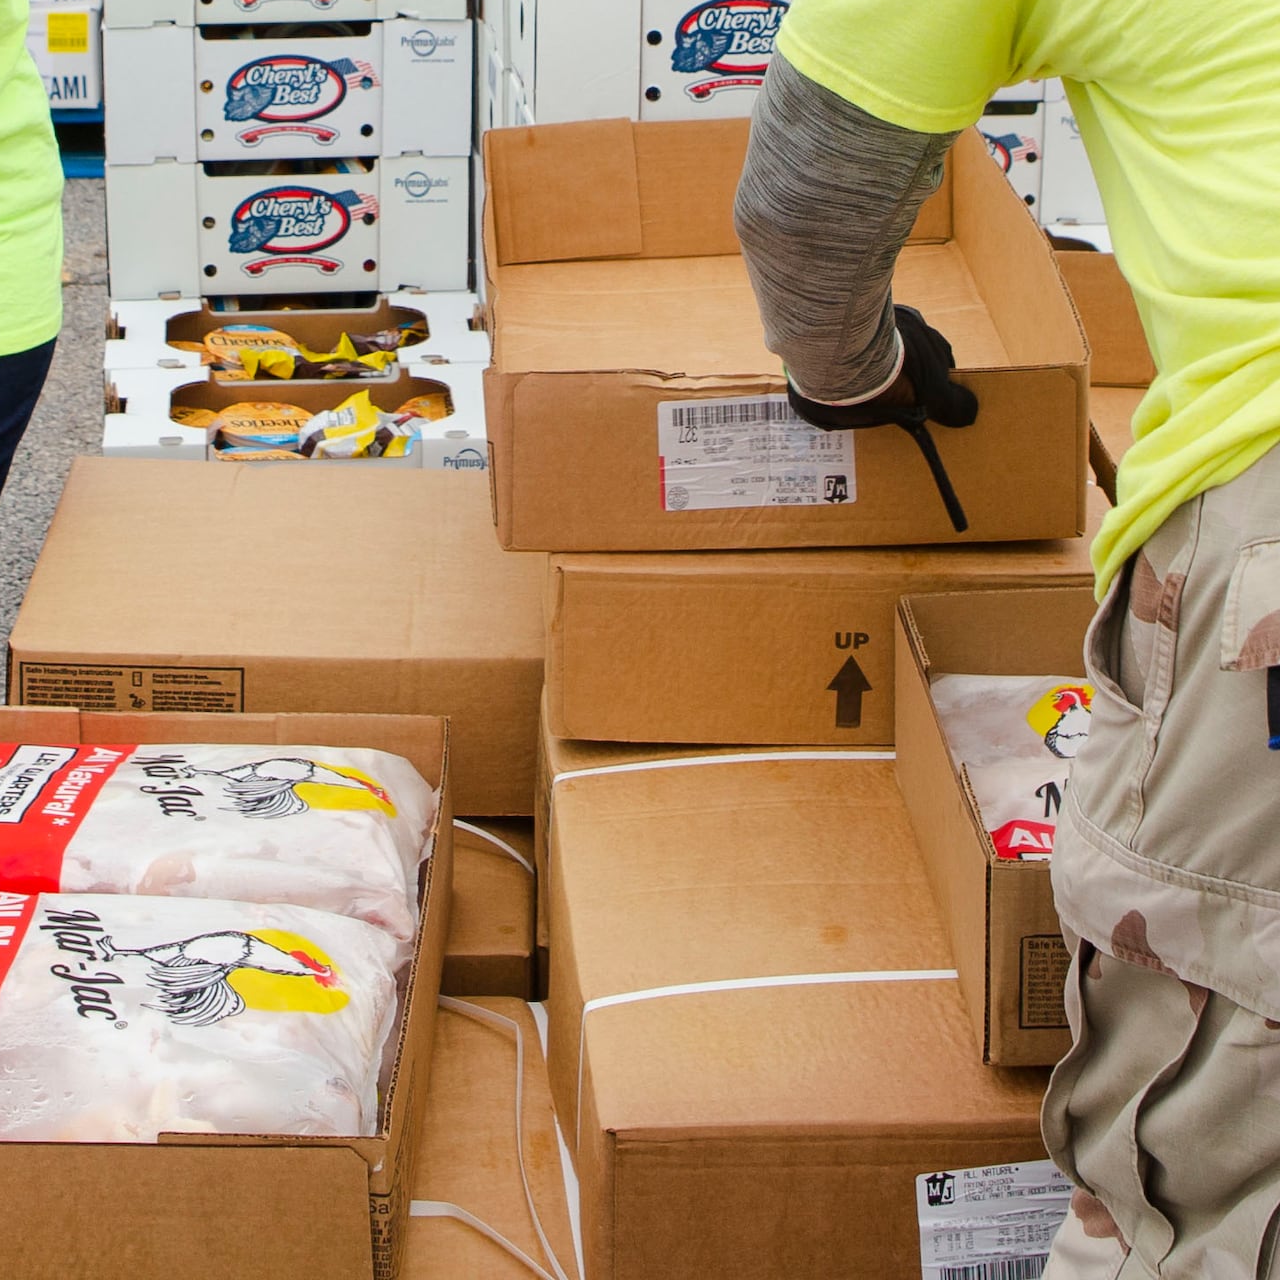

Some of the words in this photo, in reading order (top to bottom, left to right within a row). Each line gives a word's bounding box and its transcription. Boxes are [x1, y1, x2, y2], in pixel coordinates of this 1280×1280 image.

[698, 6, 786, 37] Cheryl'
[49, 74, 88, 101] AMI
[244, 63, 330, 90] Cheryl's
[272, 83, 321, 106] Best
[249, 195, 334, 222] Cheryl's
[276, 216, 325, 238] Best
[209, 334, 286, 350] Cheerios
[677, 425, 699, 445] 327
[442, 455, 487, 470] PrimusL
[834, 631, 871, 651] UP
[43, 666, 78, 678] Handling
[78, 668, 124, 678] Instructions
[38, 908, 126, 1021] Mar-Jac
[962, 1170, 978, 1180] ALL
